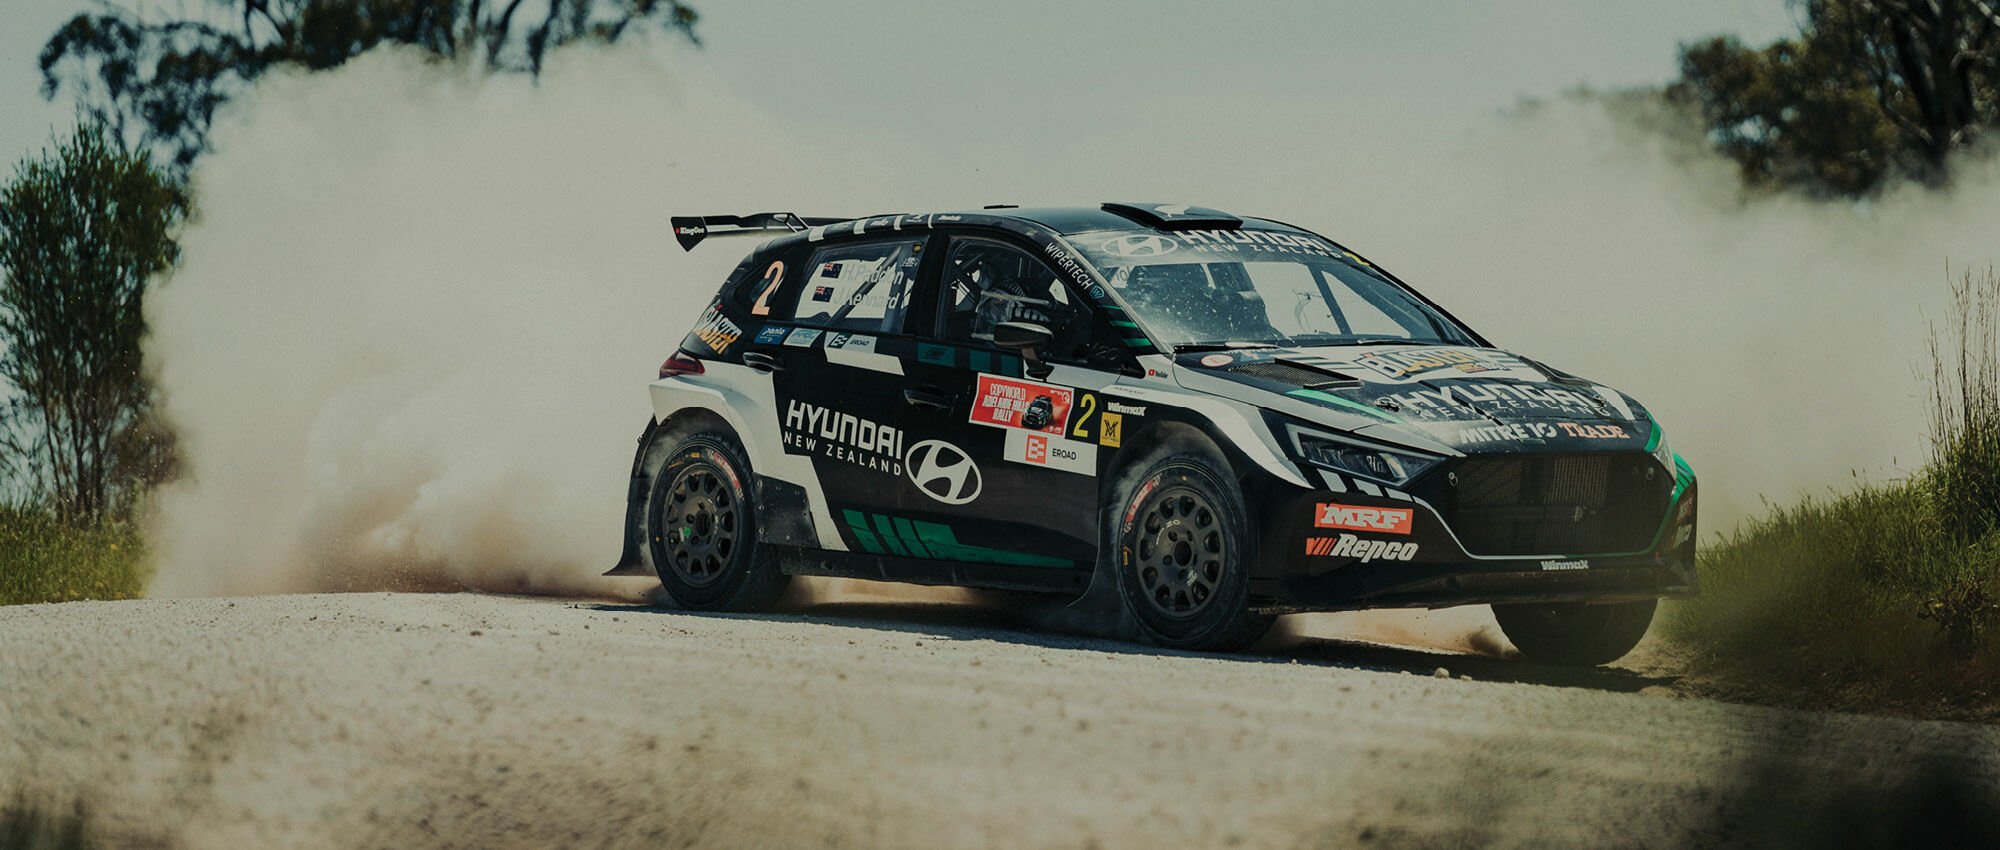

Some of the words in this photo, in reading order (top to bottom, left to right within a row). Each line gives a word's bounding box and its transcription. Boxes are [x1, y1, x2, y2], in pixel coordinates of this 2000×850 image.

[1173, 229, 1333, 252] HYUNDAI
[1193, 243, 1240, 254] NEW
[1044, 242, 1094, 291] WIPERTECH
[751, 260, 784, 316] 2
[1396, 384, 1599, 411] HYUNDAI
[786, 398, 904, 460] HYUNDAI
[1073, 393, 1096, 438] 2
[1460, 422, 1528, 445] MITRE
[784, 430, 817, 452] NEW
[825, 443, 902, 477] ZEALAND
[1052, 447, 1077, 461] EROAD
[1320, 505, 1408, 529] MRF
[1329, 532, 1420, 564] Repco
